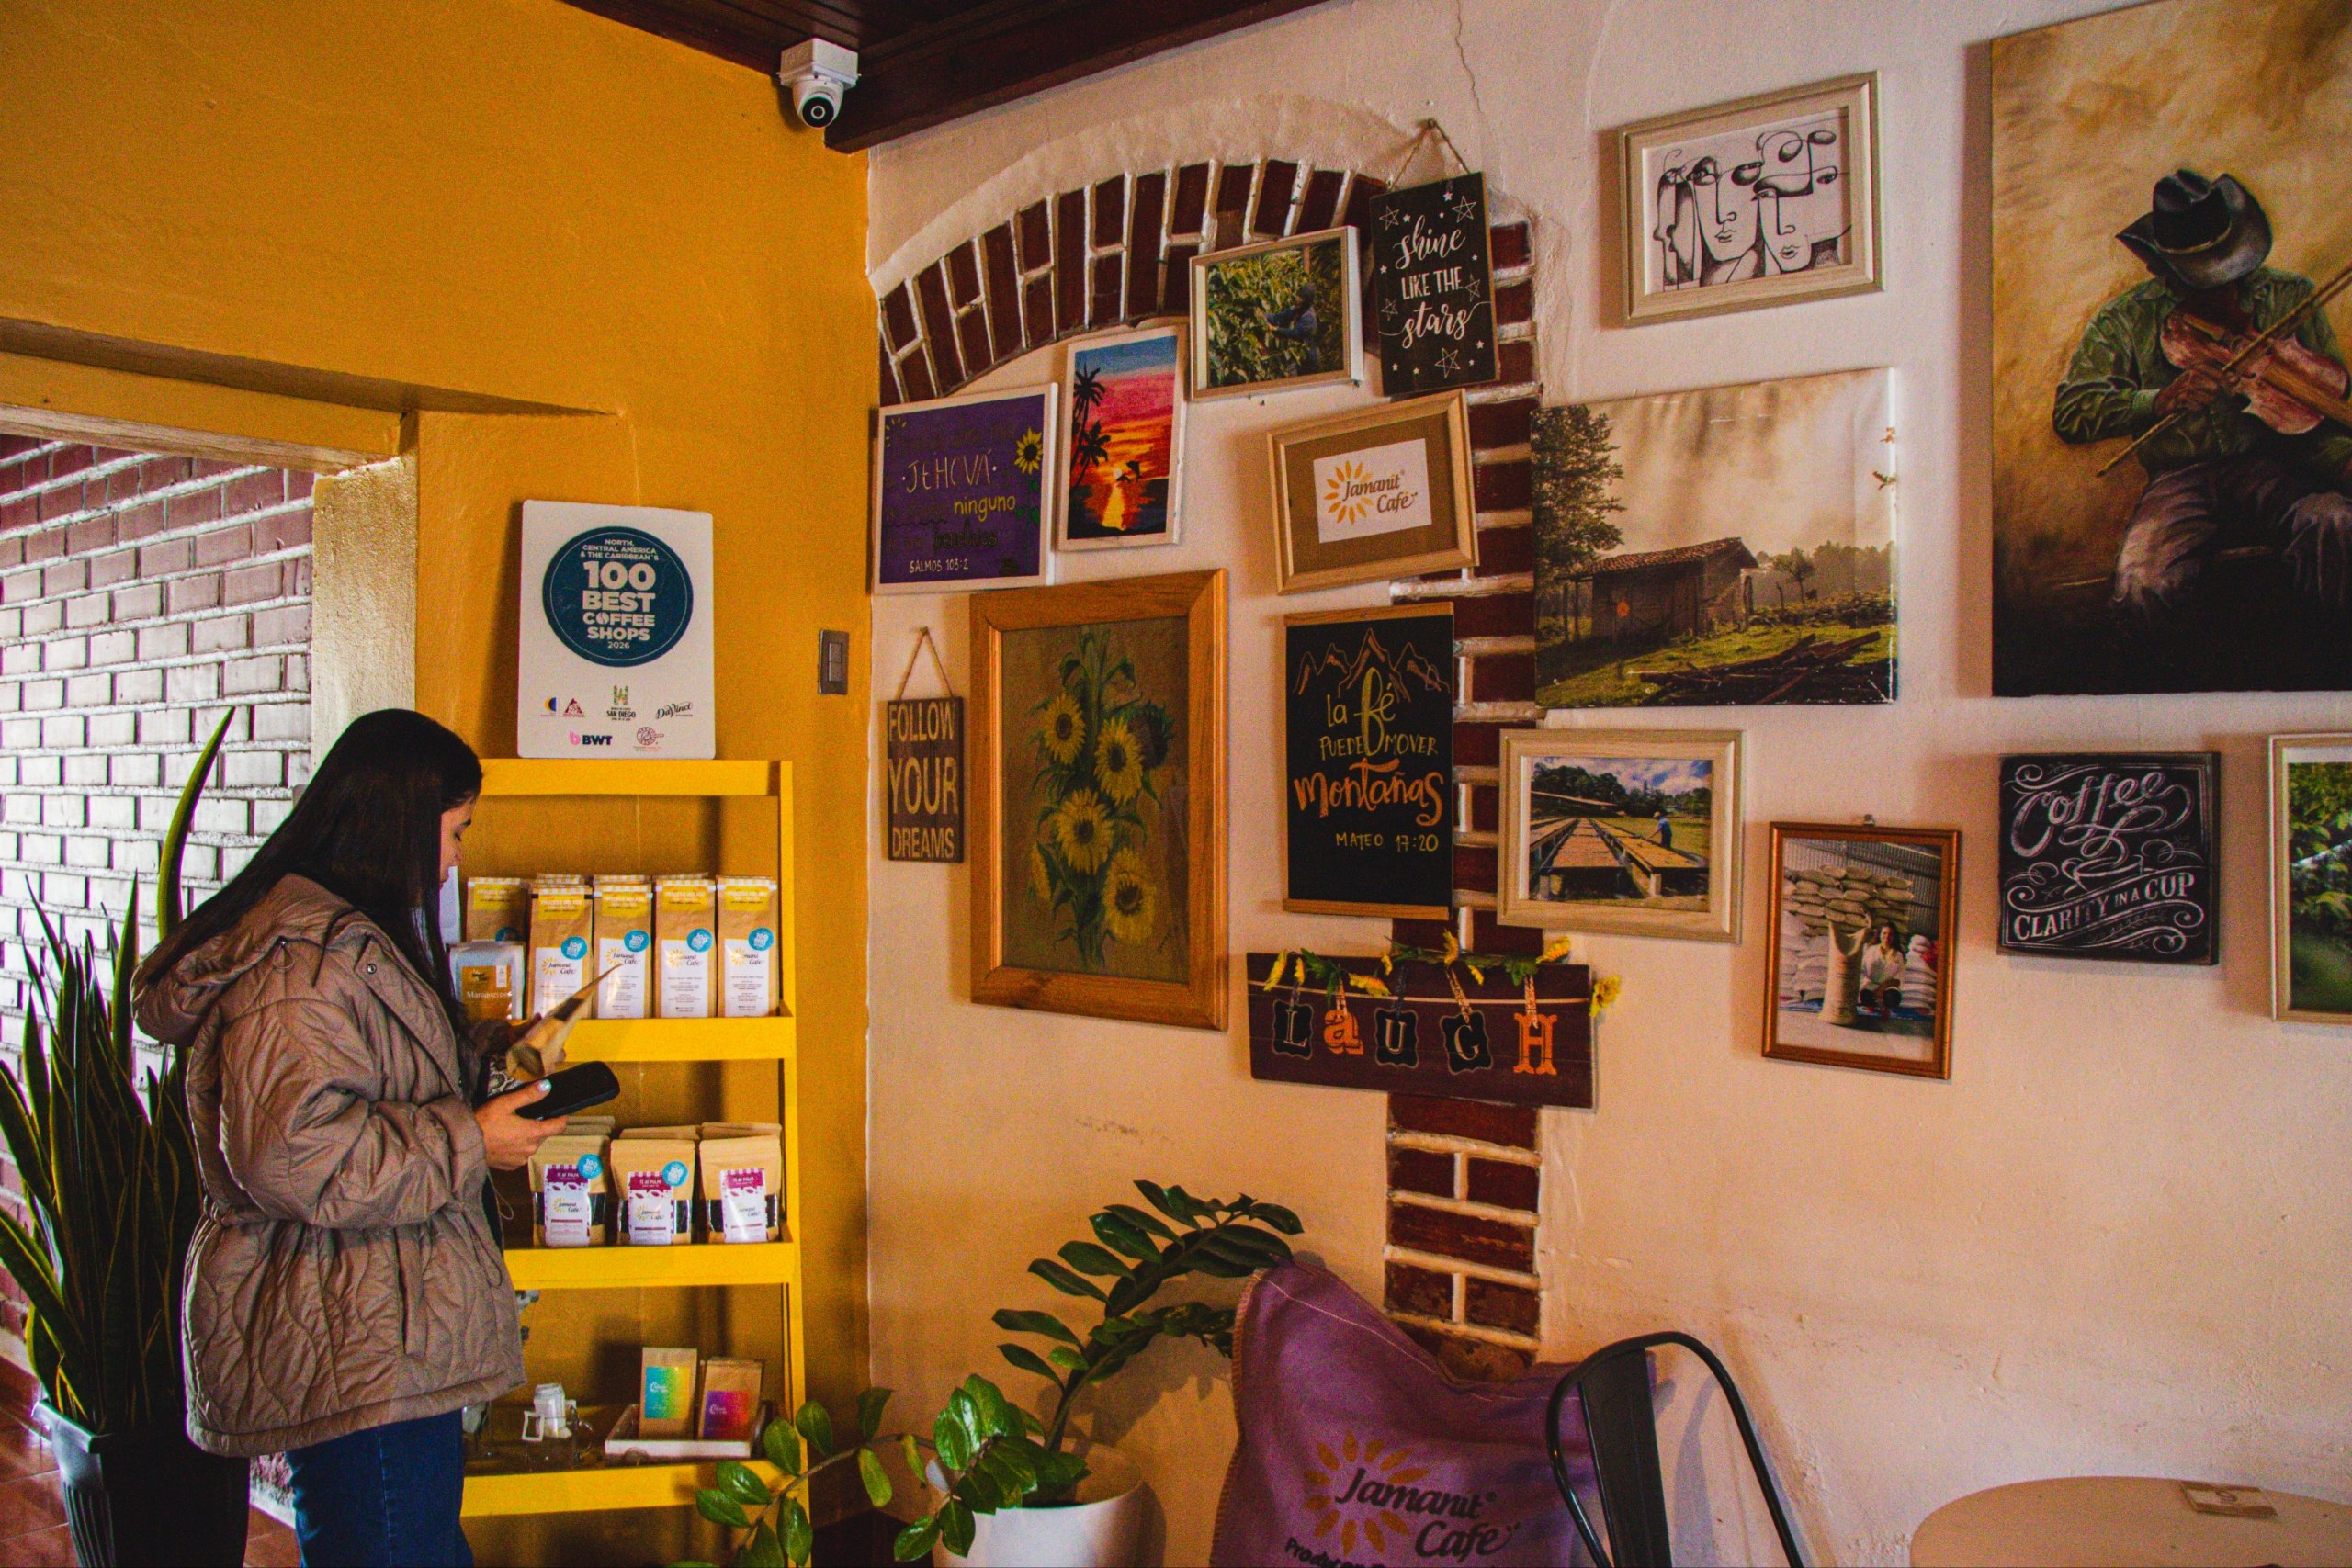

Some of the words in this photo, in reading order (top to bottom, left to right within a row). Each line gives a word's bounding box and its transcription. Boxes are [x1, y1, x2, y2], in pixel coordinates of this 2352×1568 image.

[1401, 272, 1431, 300] LIKE
[1433, 266, 1463, 294] THE
[1395, 301, 1474, 349] stars
[1342, 474, 1401, 502] Jamanit
[954, 495, 1016, 523] ninguno
[1376, 491, 1416, 514] Café
[582, 560, 656, 591] 100
[909, 559, 943, 574] SALMOS
[945, 558, 969, 571] 103:2
[582, 590, 656, 612] BEST
[582, 611, 656, 626] COFFEE
[587, 626, 650, 641] SHOPS
[618, 710, 636, 718] DIEGO
[888, 701, 956, 742] FOLLOW
[582, 735, 613, 746] BWT
[1319, 735, 1364, 761] PUEDE
[1385, 734, 1439, 756] MOVER
[888, 756, 959, 815] YOUR
[2010, 772, 2174, 858] Coffee
[892, 827, 956, 860] DREAMS
[1336, 832, 1385, 848] MATEO
[1395, 833, 1439, 852] 17:20
[2014, 896, 2109, 941] CLARITY
[2115, 893, 2128, 907] IN
[2131, 888, 2140, 902] A
[2144, 872, 2195, 901] CUP
[1335, 1467, 1484, 1519] Jamanit
